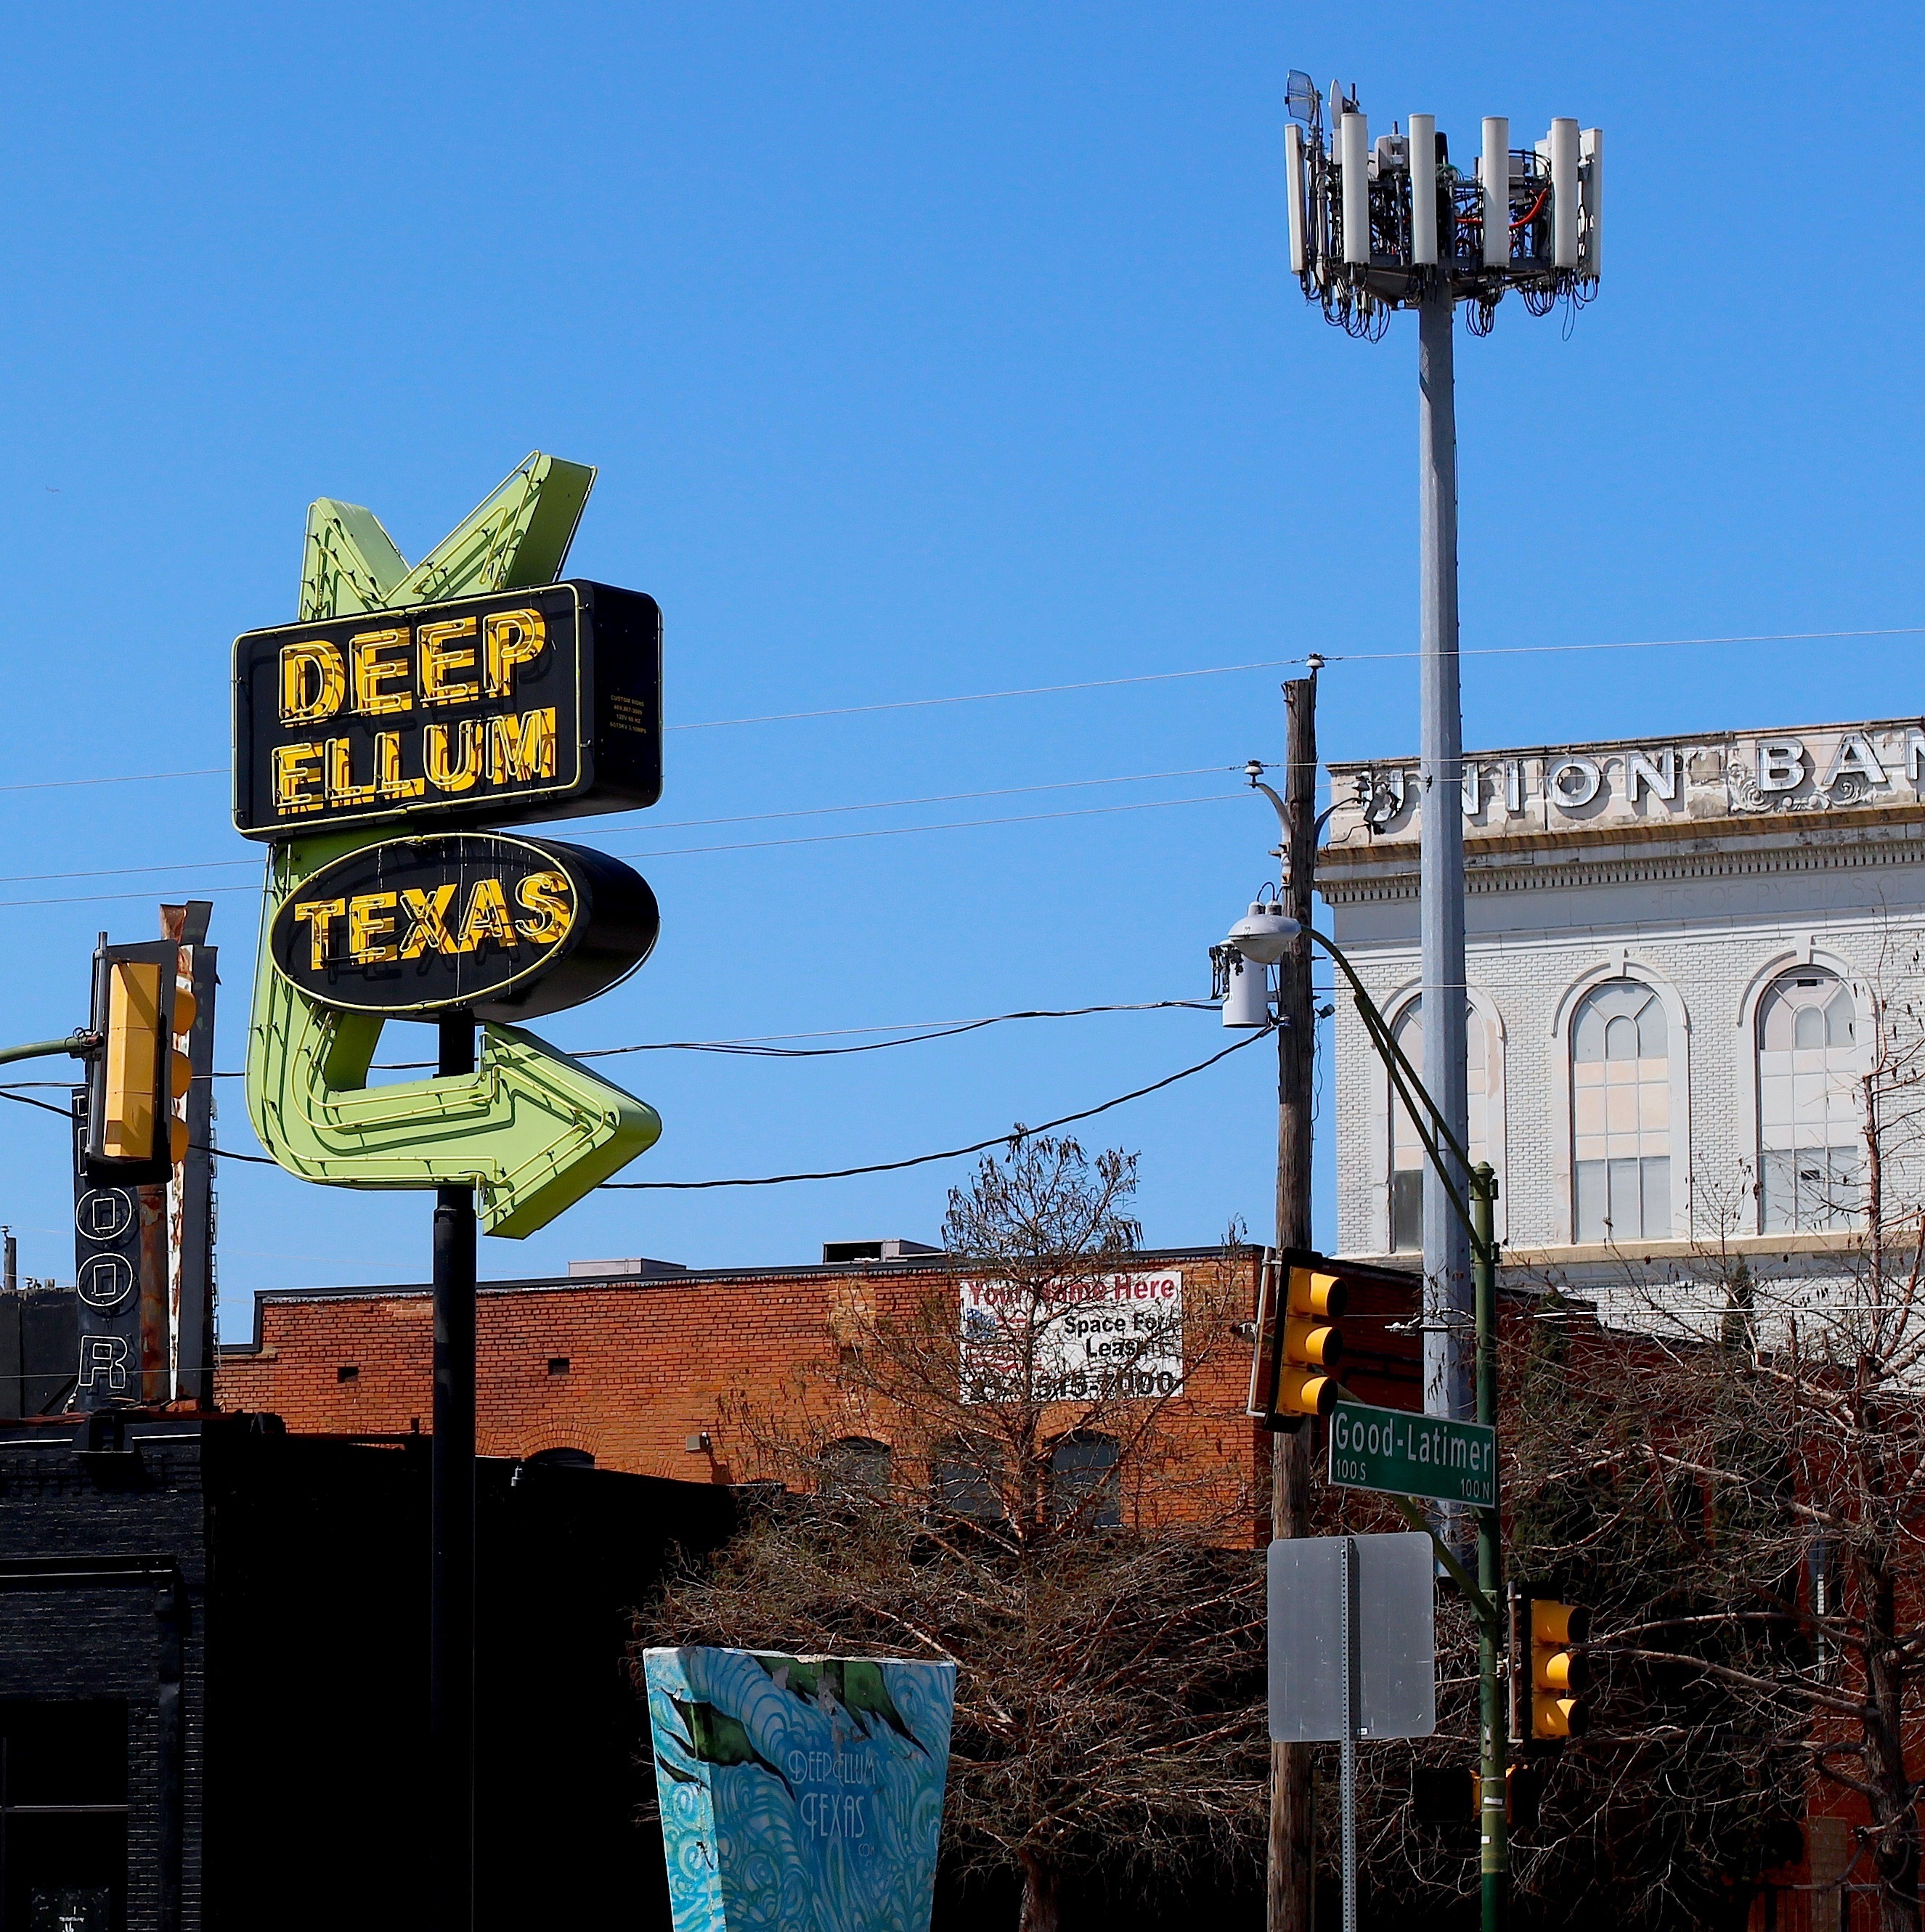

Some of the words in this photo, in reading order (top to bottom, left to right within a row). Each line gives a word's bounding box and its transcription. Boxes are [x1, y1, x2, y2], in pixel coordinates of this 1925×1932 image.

[278, 607, 547, 729] DEEP
[271, 706, 556, 817] ELLUM
[294, 871, 572, 971] TEXAS
[1115, 1274, 1176, 1300] Here
[1064, 1315, 1126, 1338] Space
[1086, 1338, 1149, 1358] Leas
[1335, 1412, 1491, 1472] Good-Latimer
[788, 1750, 832, 1785] DEEP
[832, 1751, 876, 1787] ELLUM
[800, 1793, 865, 1843] TEXAS
